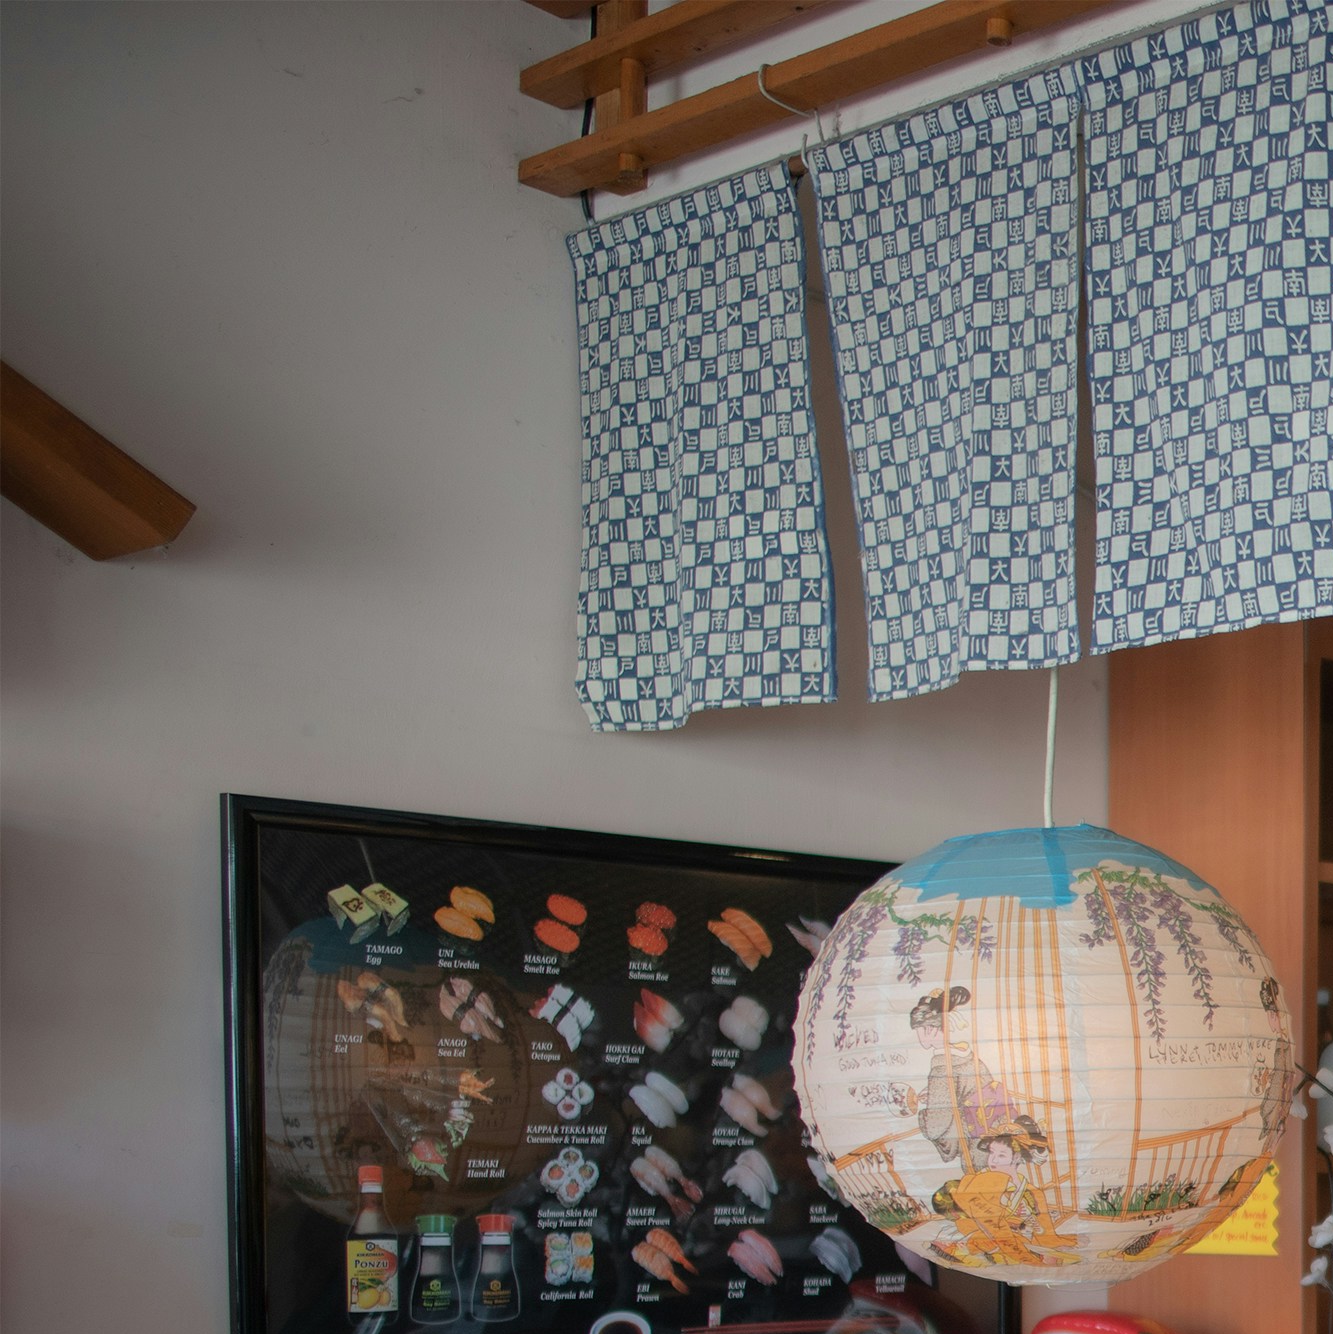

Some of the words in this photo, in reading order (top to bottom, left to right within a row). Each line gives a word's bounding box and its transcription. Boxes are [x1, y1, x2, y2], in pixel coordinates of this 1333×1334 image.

[366, 944, 403, 955] TAMAGO
[438, 949, 454, 958] UNI
[366, 955, 382, 965] Egg
[524, 954, 557, 965] MASAGO
[438, 959, 452, 968] Sea
[454, 960, 480, 970] Urchin
[628, 961, 652, 971] IKURA
[524, 964, 545, 975] Smelt
[546, 966, 560, 976] Roe
[711, 967, 730, 976] SAKE
[628, 971, 654, 981] Salmon
[655, 973, 669, 982] Roe
[711, 976, 736, 986] Salmon
[335, 1034, 363, 1044] UNAGI
[438, 1038, 467, 1047] ANAGO
[335, 1044, 349, 1054] Eel
[531, 1041, 553, 1051] TAKO
[605, 1044, 631, 1054] HOKKI
[631, 1045, 645, 1055] GAI
[438, 1048, 452, 1057] Sea
[453, 1048, 466, 1058] Eel
[531, 1051, 561, 1062] Octopus
[711, 1049, 740, 1058] HOTATE
[605, 1055, 620, 1064] Surf
[621, 1055, 640, 1064] Clam
[711, 1058, 736, 1069] Scallop
[526, 1125, 552, 1135] KAPPA
[553, 1126, 559, 1135] &
[560, 1126, 585, 1135] TEKKA
[586, 1126, 608, 1135] MAKI
[632, 1127, 645, 1135] IKA
[712, 1128, 739, 1137] AOYAGI
[526, 1135, 562, 1144] Cucumber
[563, 1136, 570, 1144] &
[571, 1135, 589, 1144] Tuna
[589, 1135, 605, 1145] Roll
[632, 1136, 652, 1145] Squid
[712, 1138, 736, 1147] Orange
[737, 1138, 754, 1146] Clam
[467, 1159, 499, 1168] TEMAKI
[467, 1169, 488, 1178] Hand
[489, 1169, 505, 1178] Roll
[537, 1209, 565, 1218] Salmon
[565, 1209, 582, 1218] Skin
[583, 1208, 598, 1218] Roll
[627, 1208, 655, 1216] AMAEBI
[714, 1207, 745, 1216] MIRUGAI
[809, 1206, 826, 1214] SABA
[537, 1218, 556, 1229] Spicy
[557, 1219, 576, 1227] Tuna
[577, 1218, 593, 1227] Roll
[626, 1217, 648, 1226] Sweet
[649, 1217, 670, 1225] Prawn
[748, 1216, 765, 1225] Clam
[809, 1215, 838, 1224] Mackerel
[354, 1259, 388, 1269] PONZU
[728, 1280, 746, 1290] KANI
[803, 1278, 832, 1287] KOHADA
[875, 1276, 906, 1285] HAMACHI
[637, 1284, 650, 1293] EBI
[803, 1287, 819, 1296] Shad
[540, 1291, 576, 1301] California
[579, 1290, 594, 1300] Roll
[636, 1293, 659, 1302] Prawn
[728, 1290, 744, 1299] Crab
